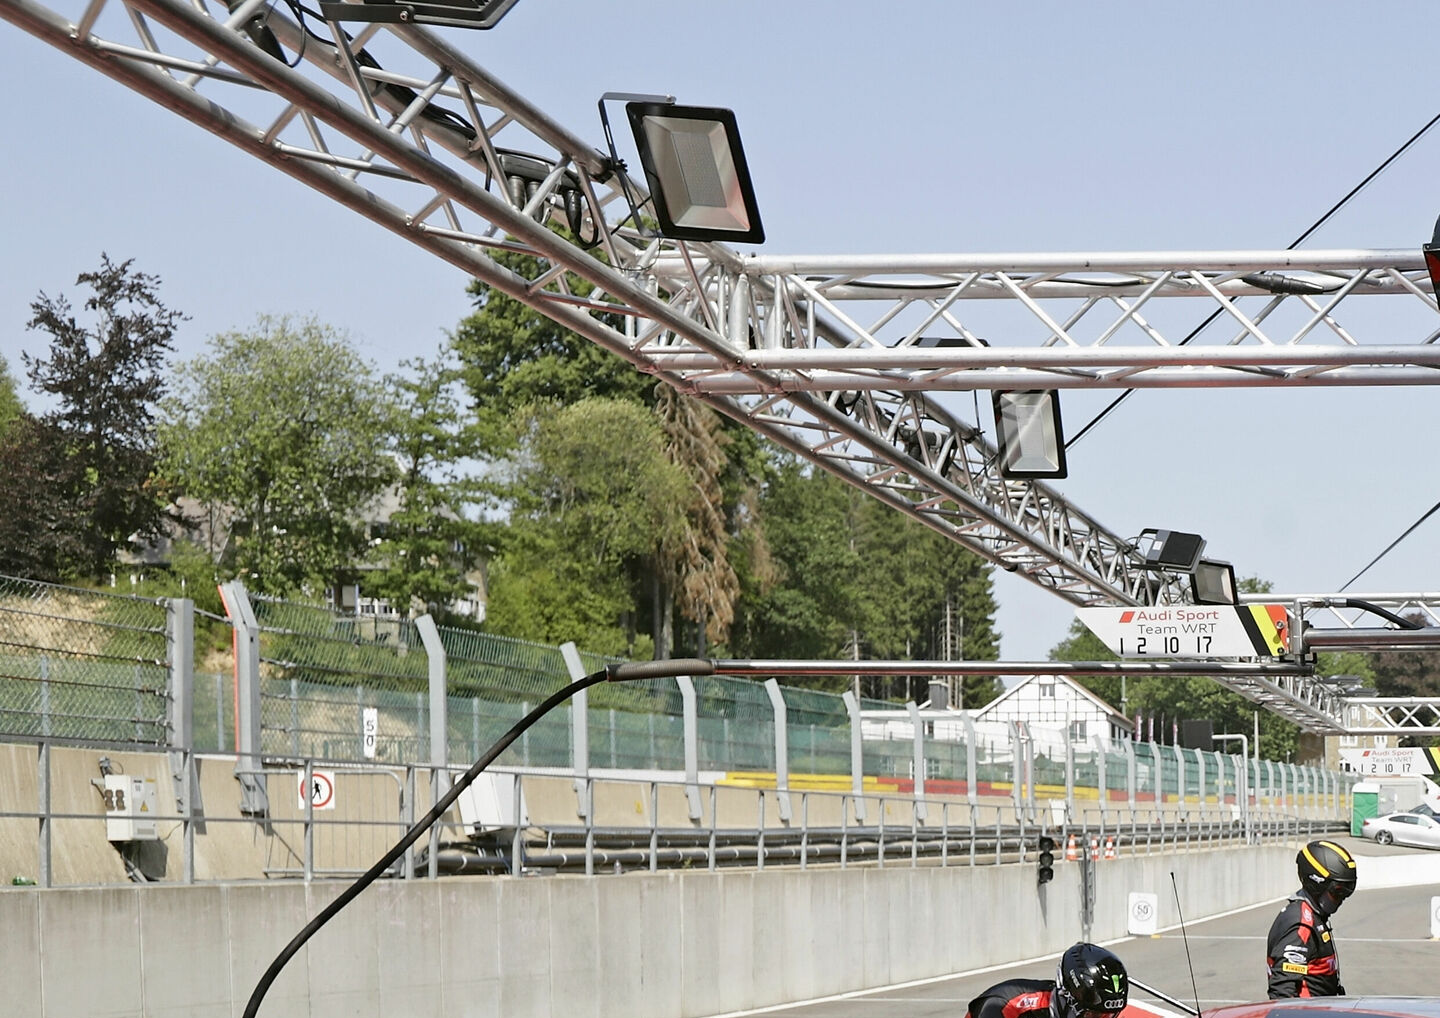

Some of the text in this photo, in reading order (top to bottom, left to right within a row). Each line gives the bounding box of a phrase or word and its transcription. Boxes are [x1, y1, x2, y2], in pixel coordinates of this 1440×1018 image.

[1137, 609, 1219, 623] Audi Sport
[1137, 623, 1217, 635] Team WRT
[1120, 637, 1212, 655] 1 2 10 17
[1372, 764, 1377, 773] 2
[1384, 764, 1393, 773] 10
[1402, 764, 1411, 773] 17
